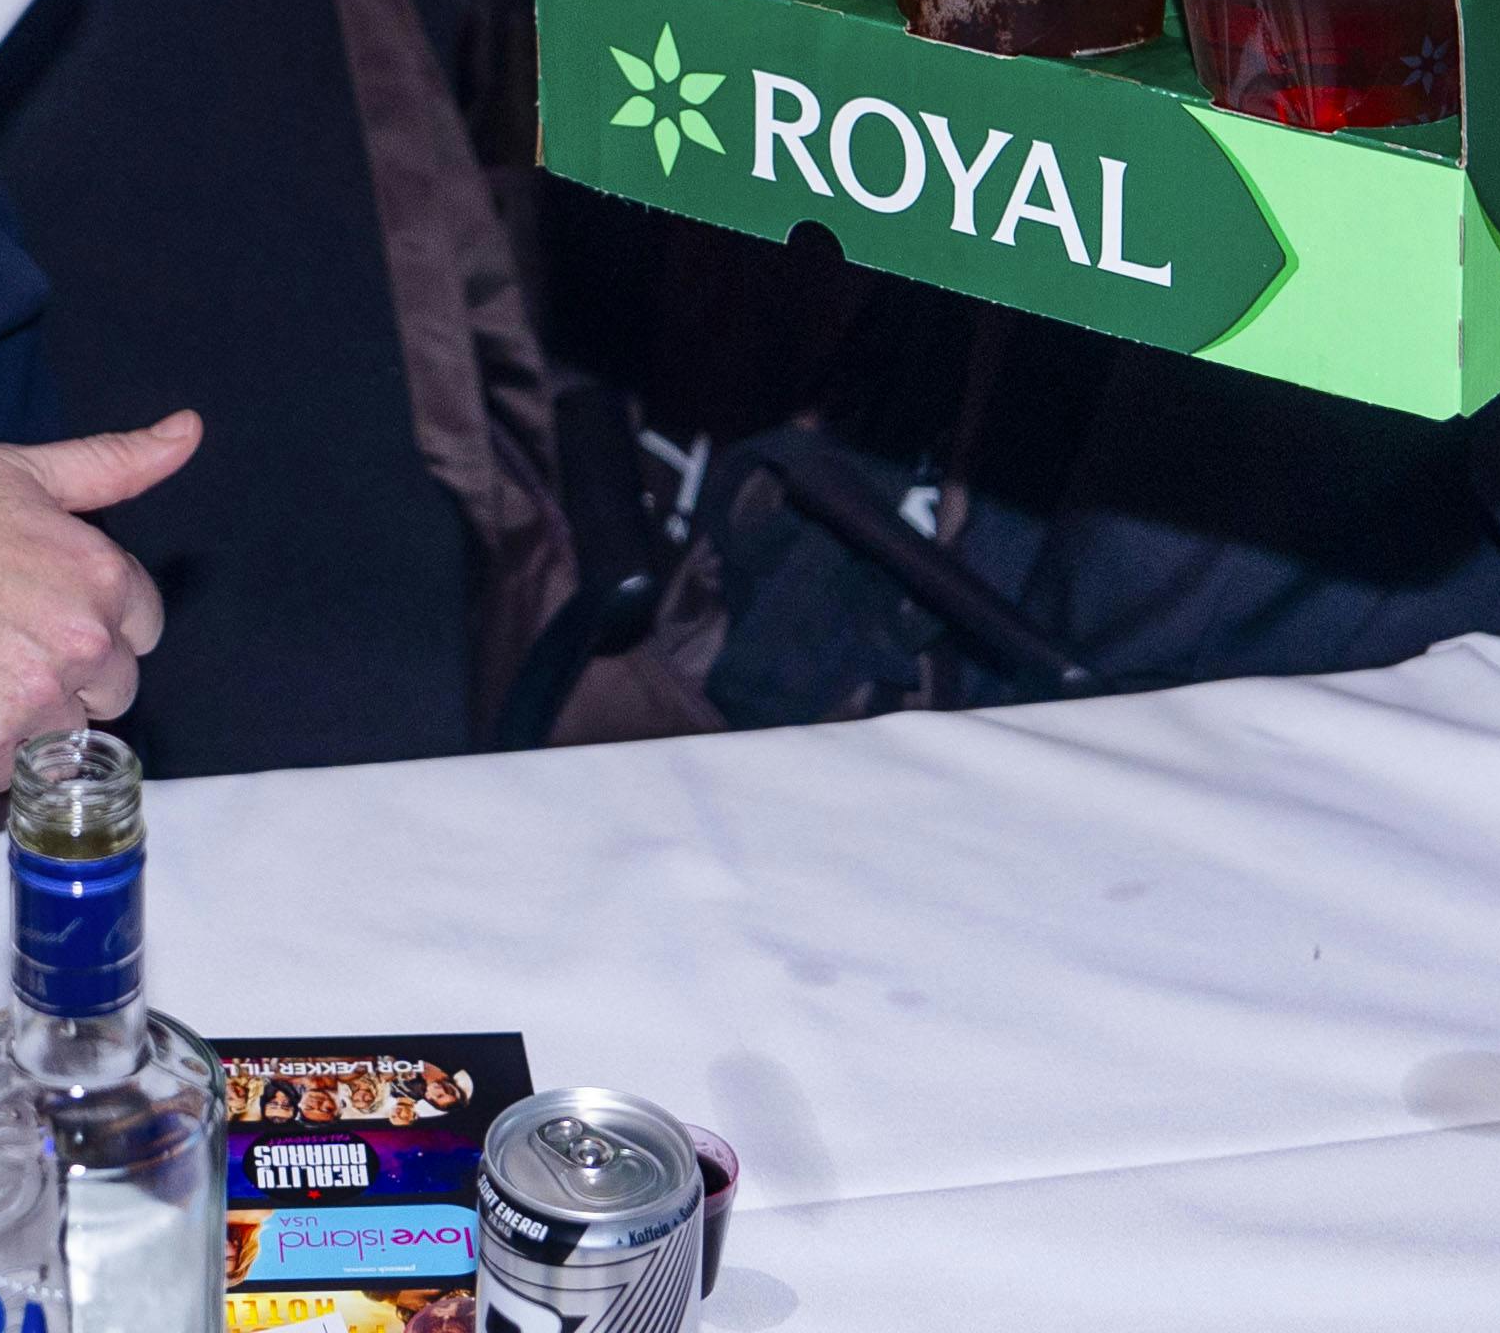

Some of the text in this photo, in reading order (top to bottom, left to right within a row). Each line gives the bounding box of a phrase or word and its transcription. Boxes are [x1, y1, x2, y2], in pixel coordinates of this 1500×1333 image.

[750, 68, 1173, 288] ROYAL
[241, 1062, 276, 1076] TIL
[279, 1061, 374, 1075] LÆKKER
[377, 1060, 425, 1073] FOR
[253, 1144, 368, 1167] AWARDS
[256, 1165, 369, 1189] REALITY
[279, 1216, 318, 1227] USA
[494, 1199, 549, 1242] ENERGI
[279, 1227, 475, 1263] love island
[628, 1221, 671, 1247] Koffein
